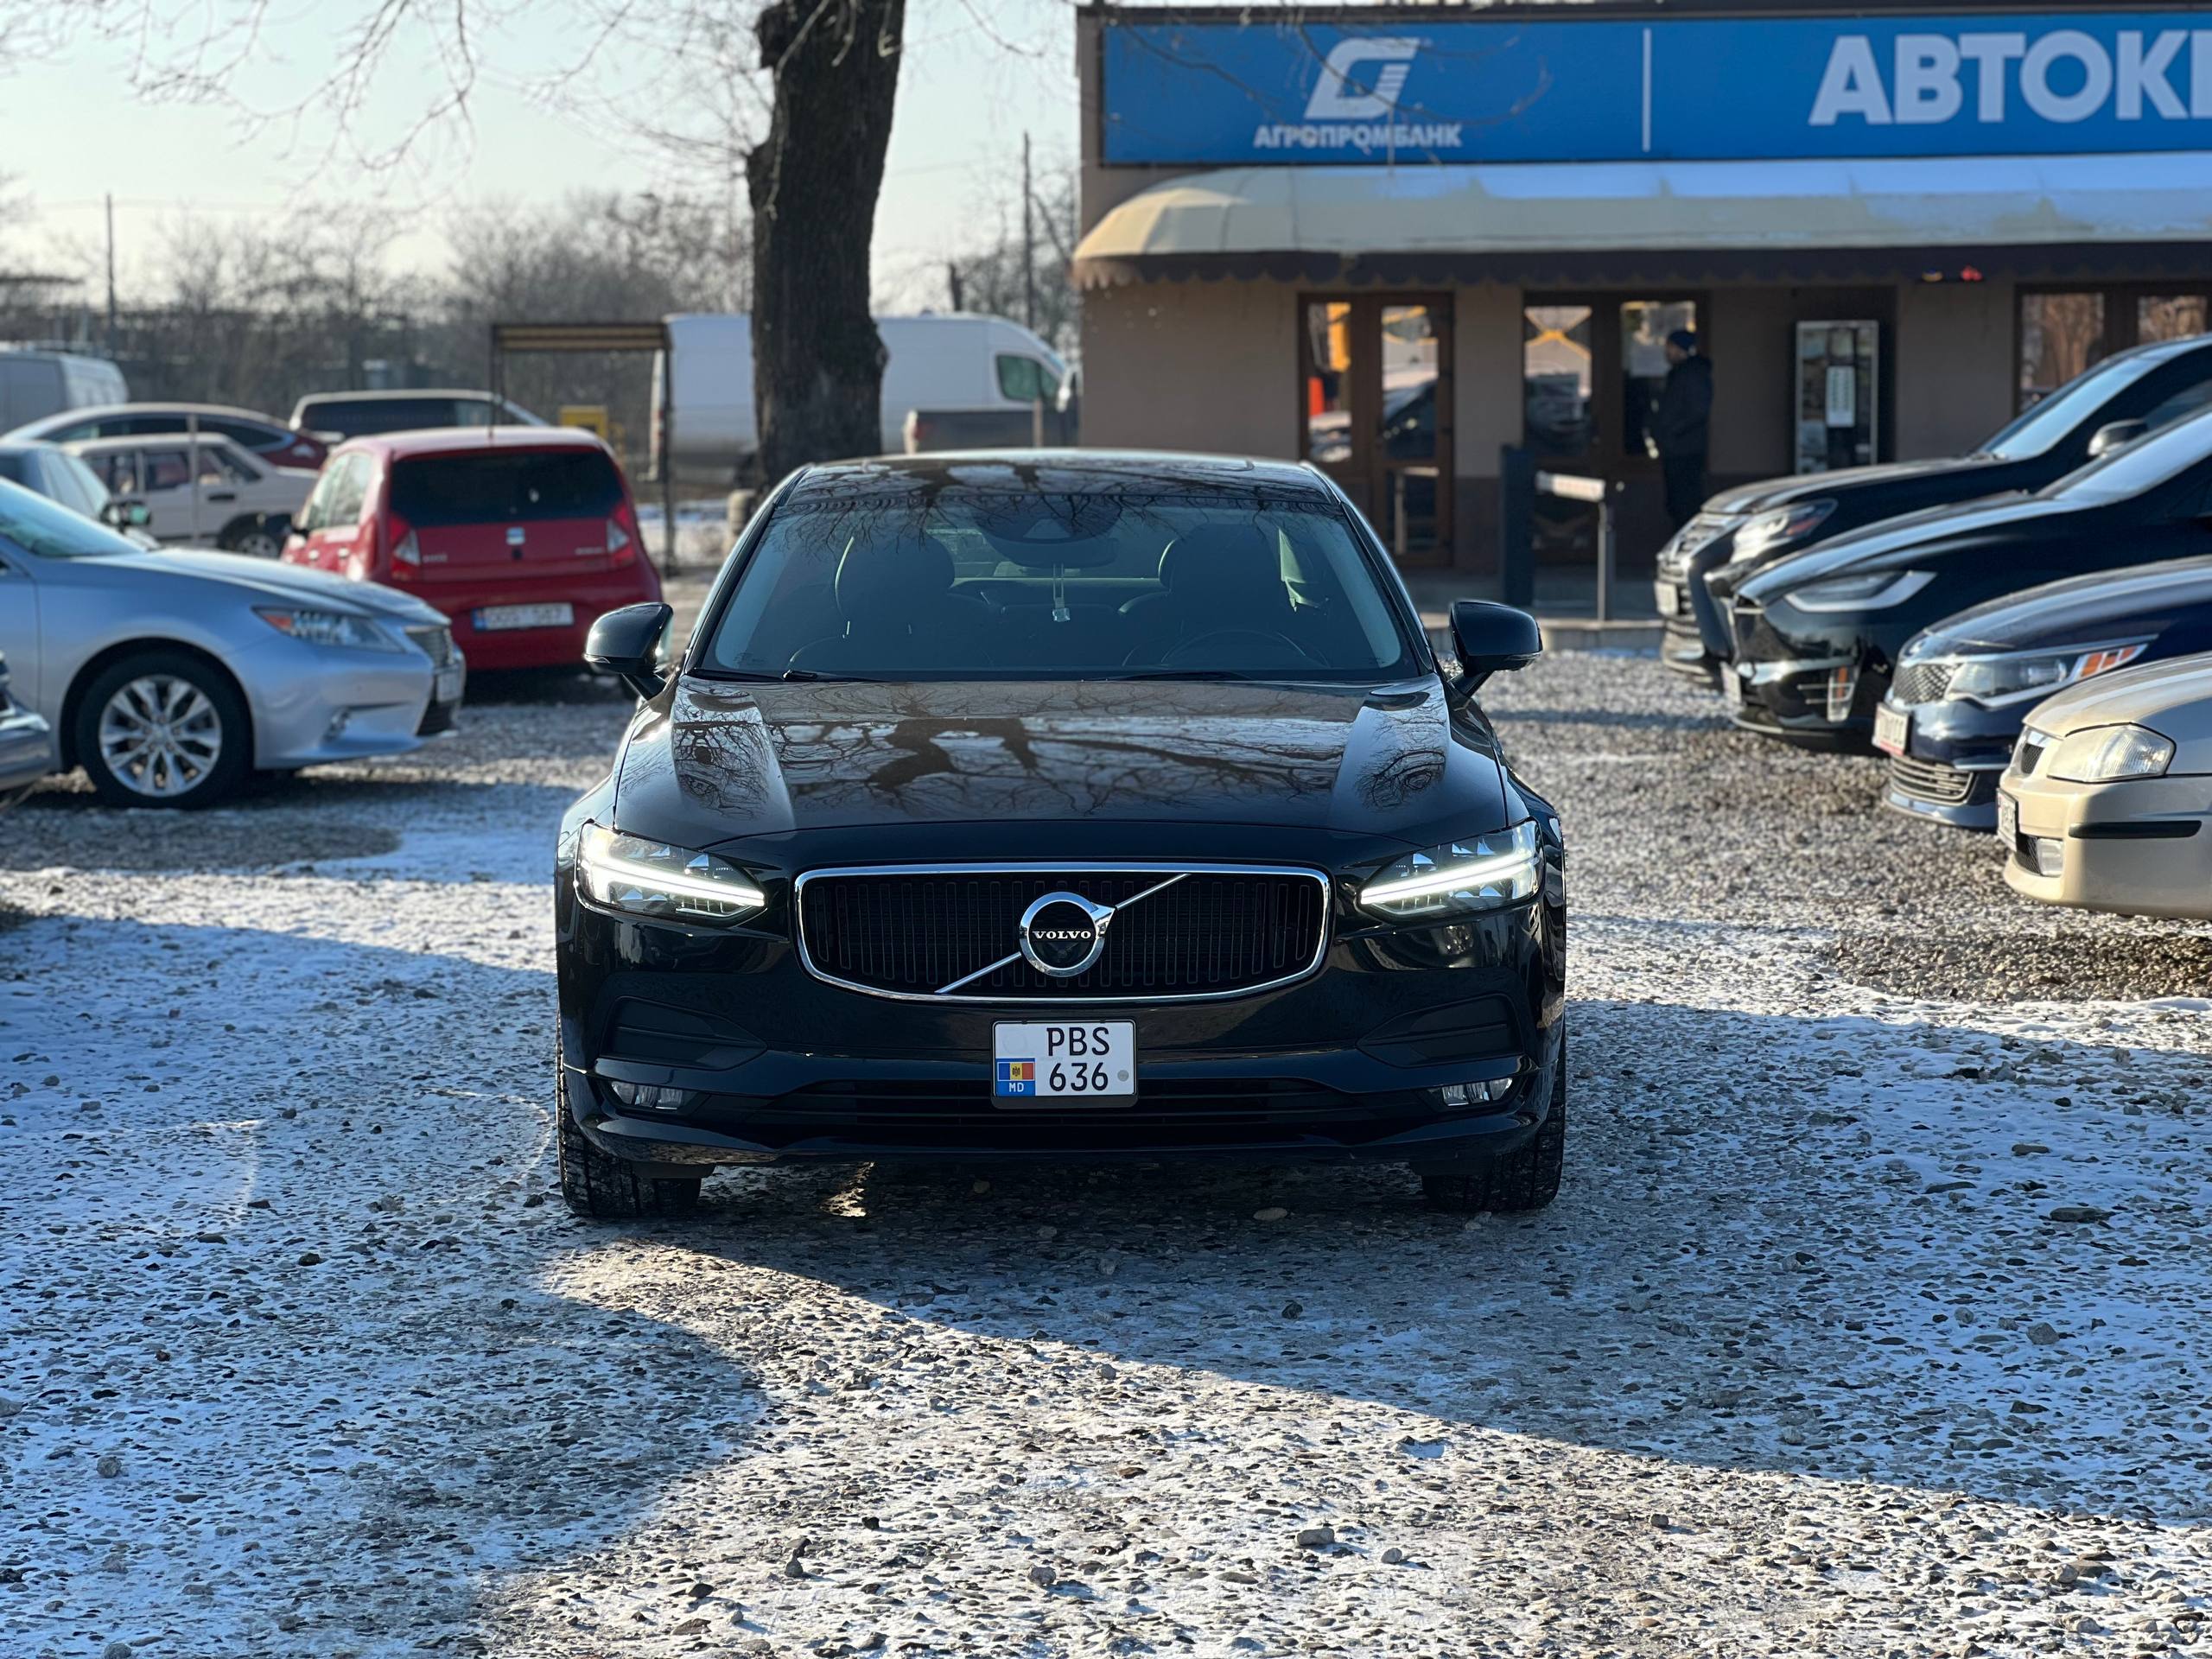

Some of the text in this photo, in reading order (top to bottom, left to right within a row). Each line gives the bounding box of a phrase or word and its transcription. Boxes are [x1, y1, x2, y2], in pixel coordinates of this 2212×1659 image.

[1808, 29, 2212, 125] АВТОК
[1254, 124, 1463, 148] АГРОПРОМБАНК
[1032, 930, 1091, 940] VOLVO
[1046, 1027, 1110, 1057] PBS
[1008, 1082, 1025, 1093] MD
[1049, 1062, 1109, 1092] 636
